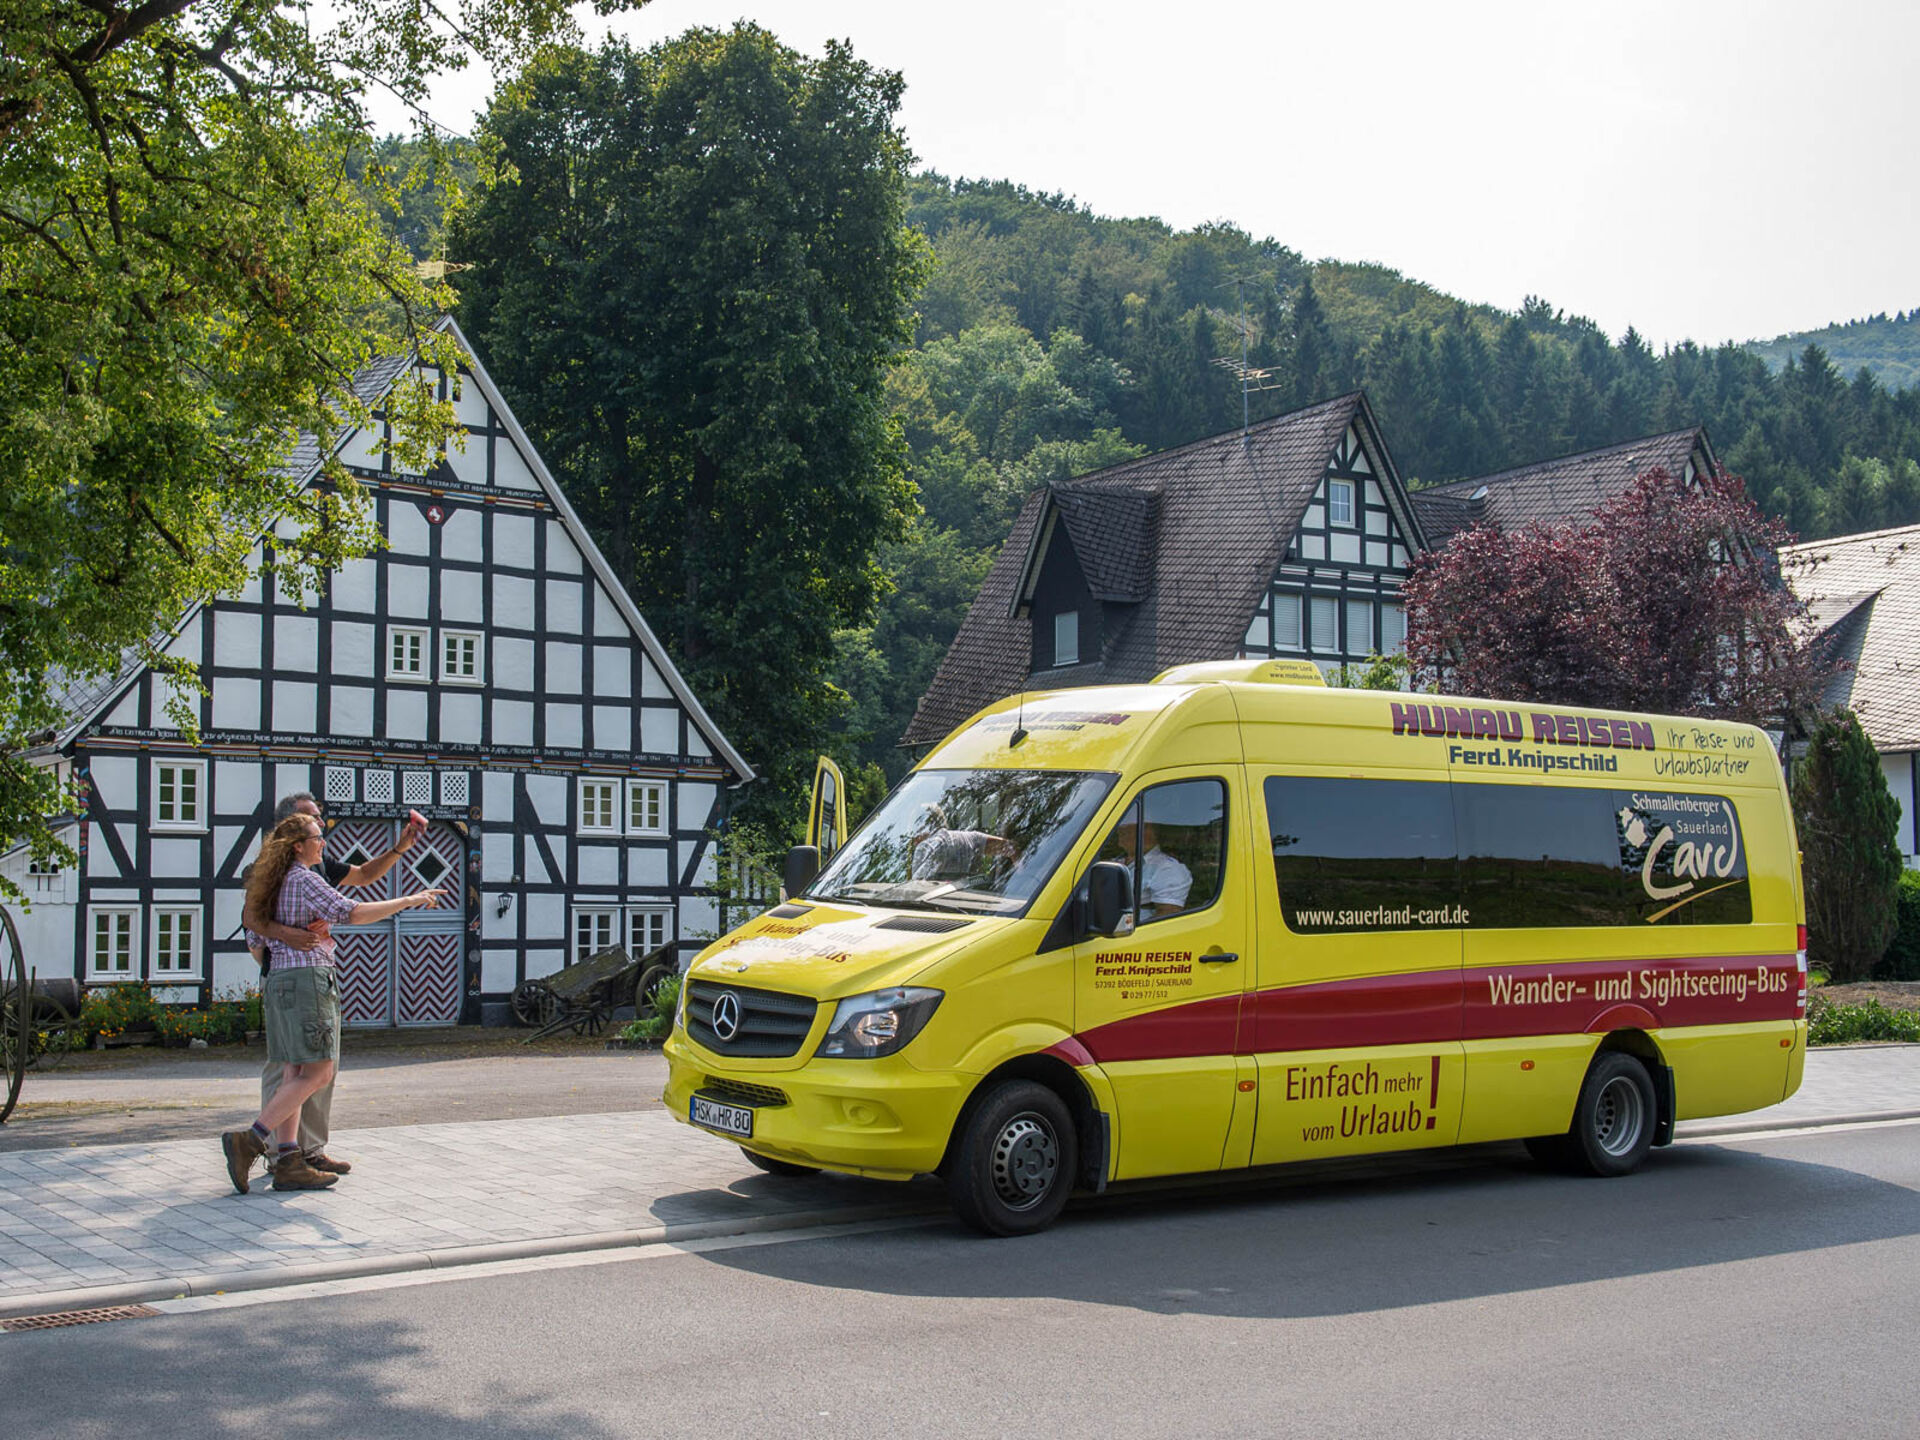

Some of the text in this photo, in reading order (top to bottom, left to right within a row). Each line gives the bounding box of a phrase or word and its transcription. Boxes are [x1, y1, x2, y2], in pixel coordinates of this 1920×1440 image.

[1390, 702, 1656, 750] HUNAU REISEN
[1667, 728, 1755, 750] Ihr Reise- und
[1654, 752, 1750, 777] Urlaubspartner
[1631, 793, 1719, 816] Schmallenberger
[1676, 820, 1728, 834] Sauerland
[1296, 905, 1469, 926] www.sauerland-card.de
[1095, 951, 1192, 964] HUNAU REISEN
[1156, 978, 1193, 987] SAUERLAND
[1488, 966, 1789, 1007] Wander- und Sightseeing-Bus
[1286, 1062, 1380, 1102] Einfach
[1384, 1072, 1423, 1093] mehr
[695, 1100, 750, 1131] HSK HR 80
[1303, 1100, 1422, 1142] vom Urlaub
